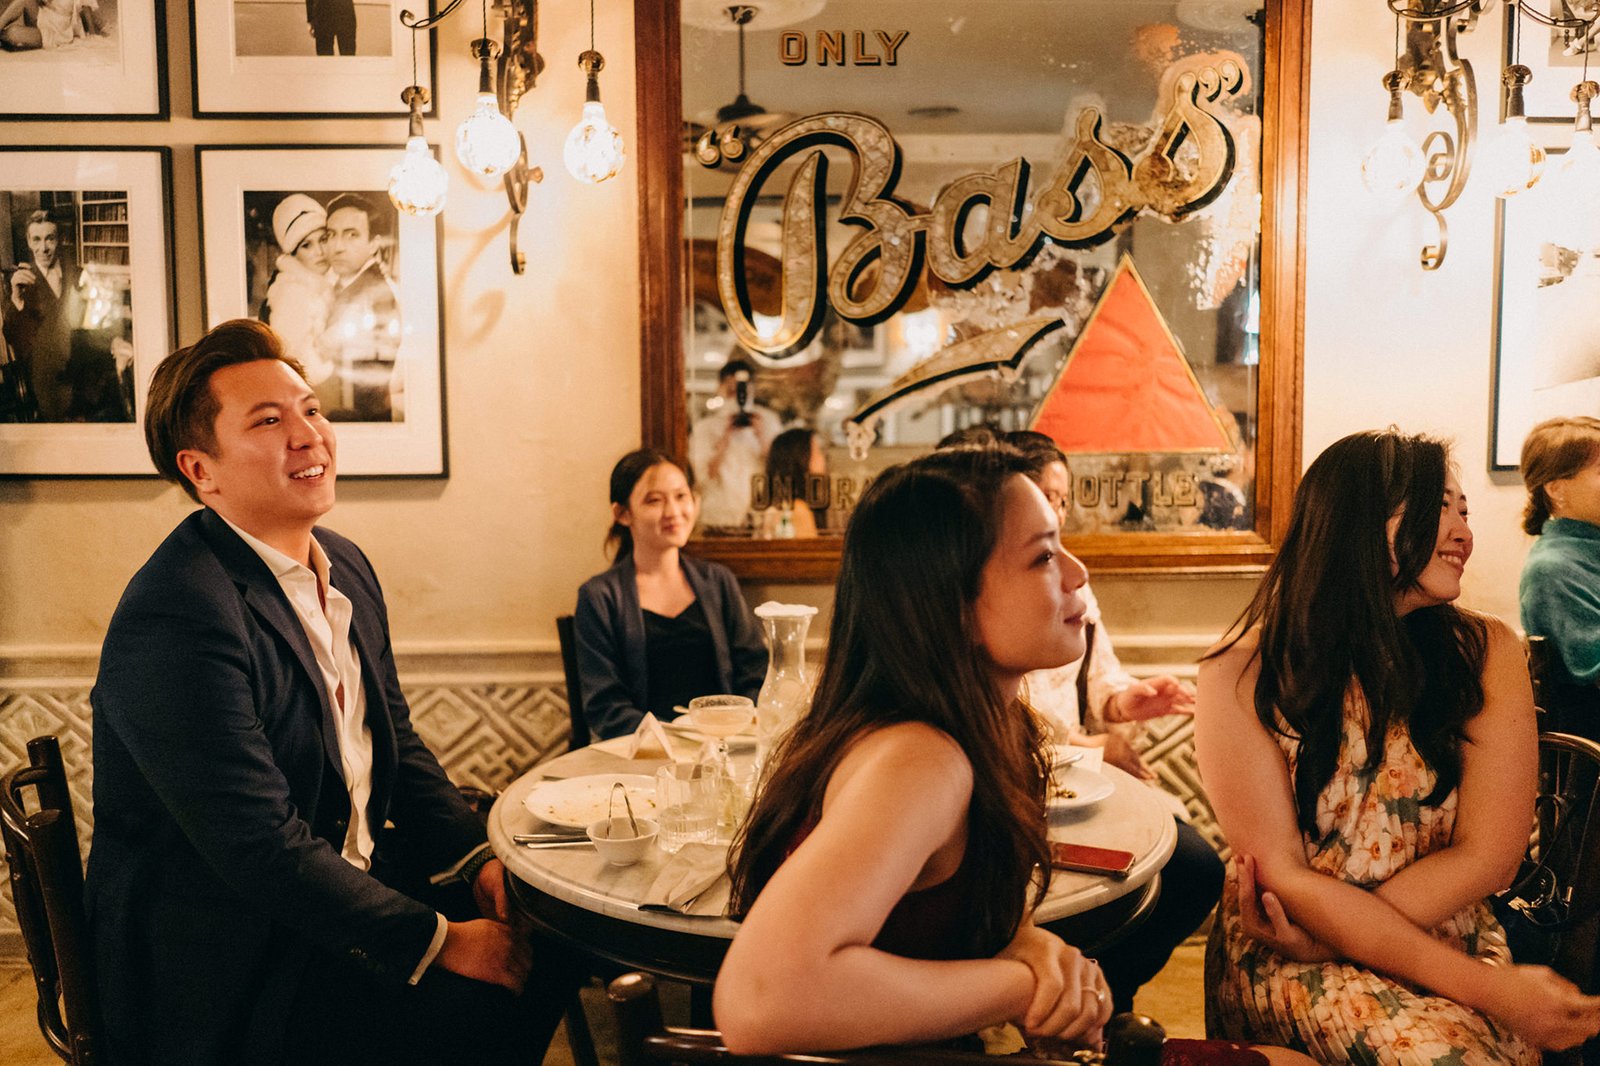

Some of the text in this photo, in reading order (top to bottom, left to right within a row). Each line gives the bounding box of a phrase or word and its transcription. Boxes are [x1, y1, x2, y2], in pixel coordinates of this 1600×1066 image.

[779, 29, 909, 66] ONLY
[751, 472, 796, 511] ON
[1068, 471, 1197, 508] OTTLE
